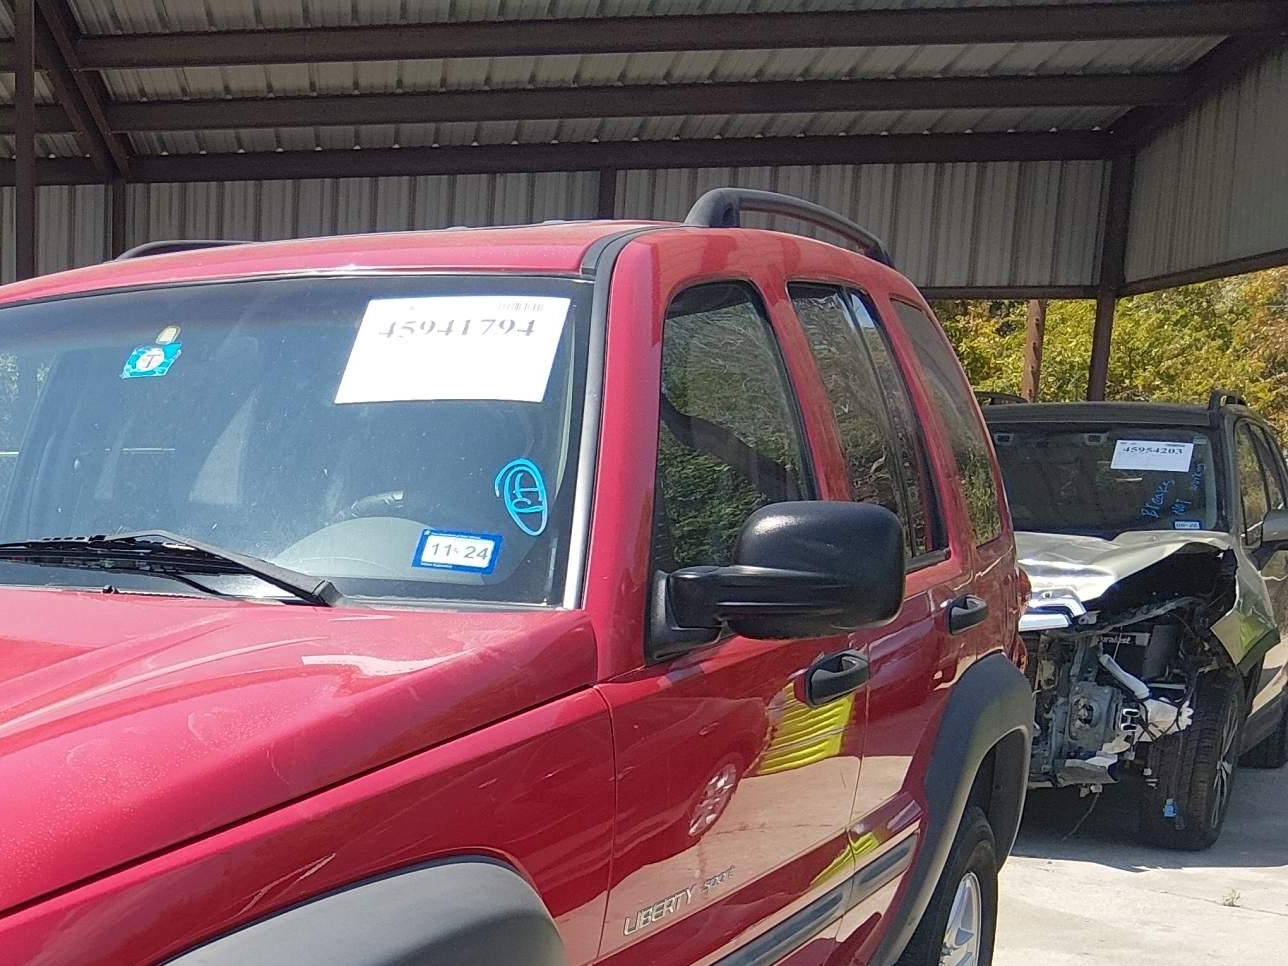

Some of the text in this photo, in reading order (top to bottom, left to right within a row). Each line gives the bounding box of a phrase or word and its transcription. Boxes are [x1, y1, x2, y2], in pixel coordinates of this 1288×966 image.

[378, 319, 535, 338] 45941794
[464, 545, 489, 561] 24
[623, 883, 696, 936] LIBERTY
